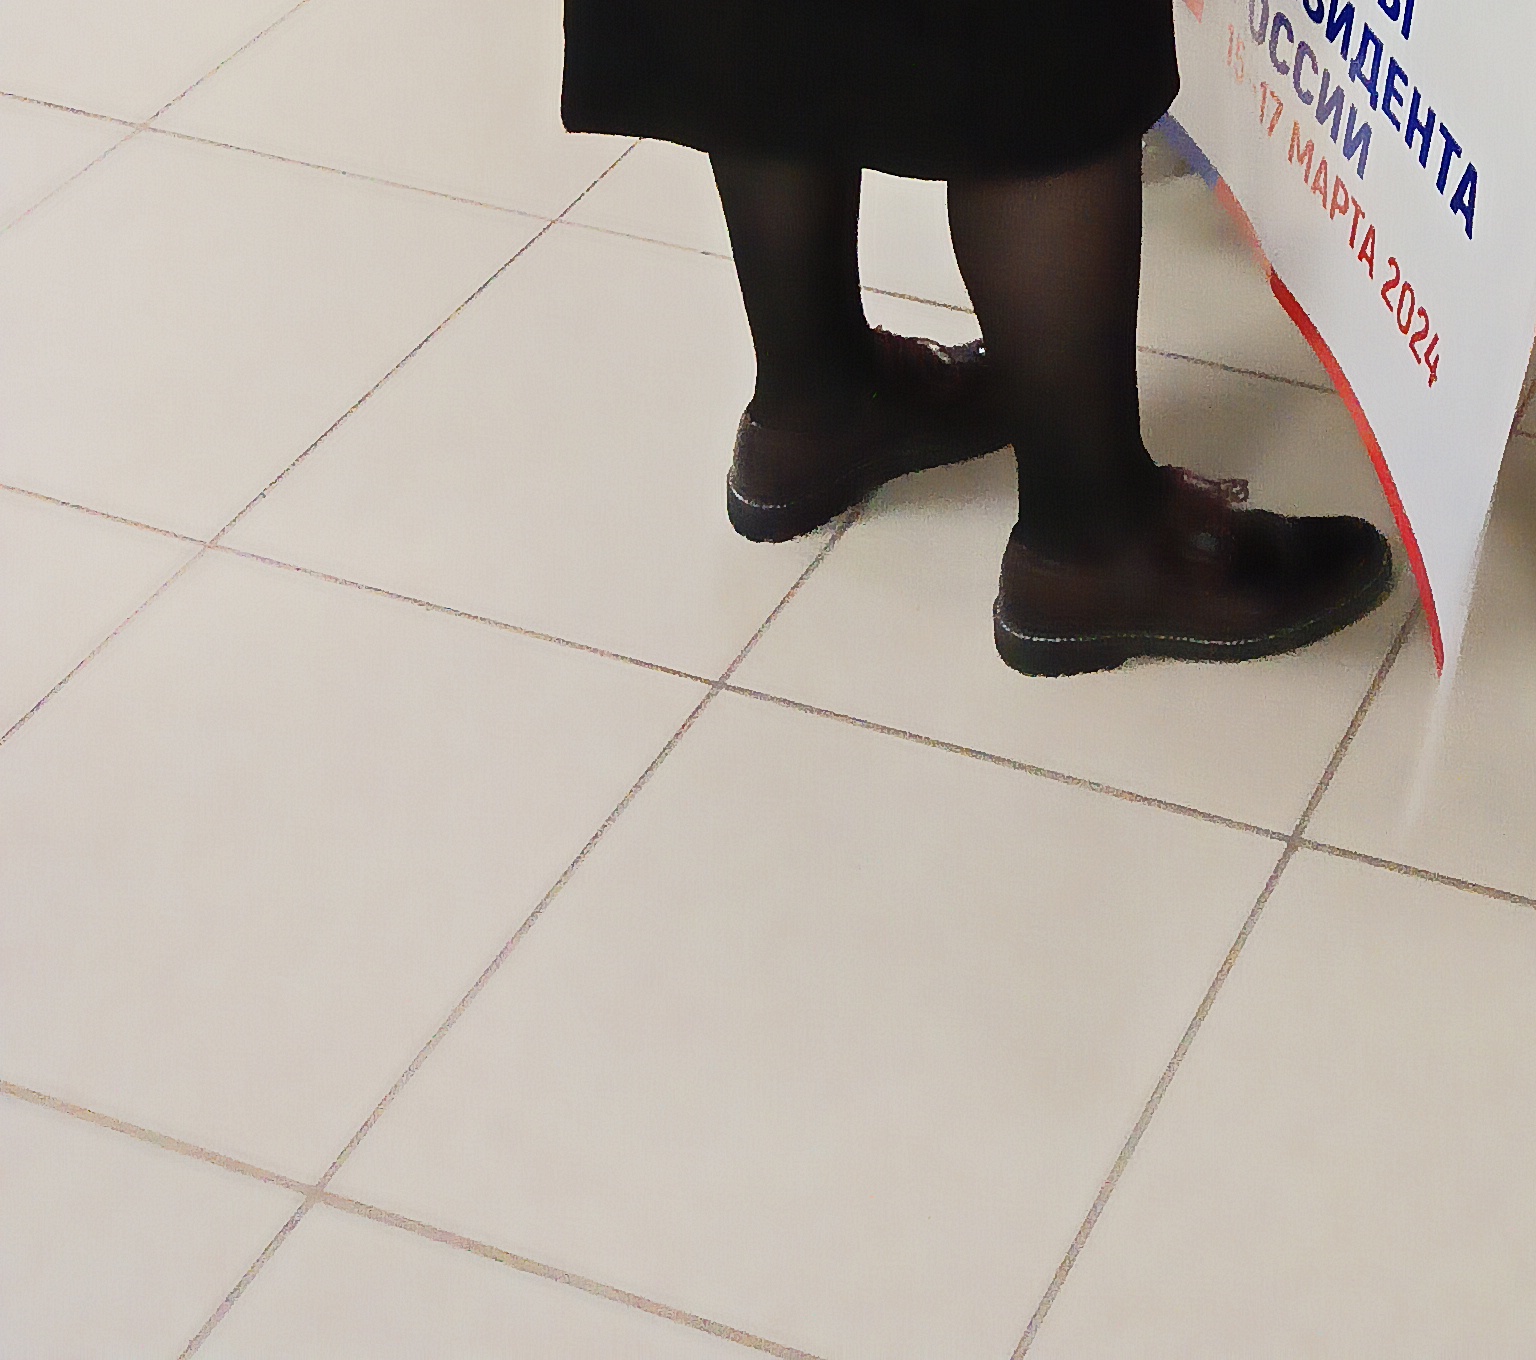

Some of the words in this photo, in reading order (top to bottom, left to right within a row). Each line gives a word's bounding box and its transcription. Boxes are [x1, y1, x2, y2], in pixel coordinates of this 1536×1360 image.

[1226, 23, 1283, 140] 1517
[1288, 118, 1376, 280] МАРТА
[1379, 256, 1442, 388] 2024
